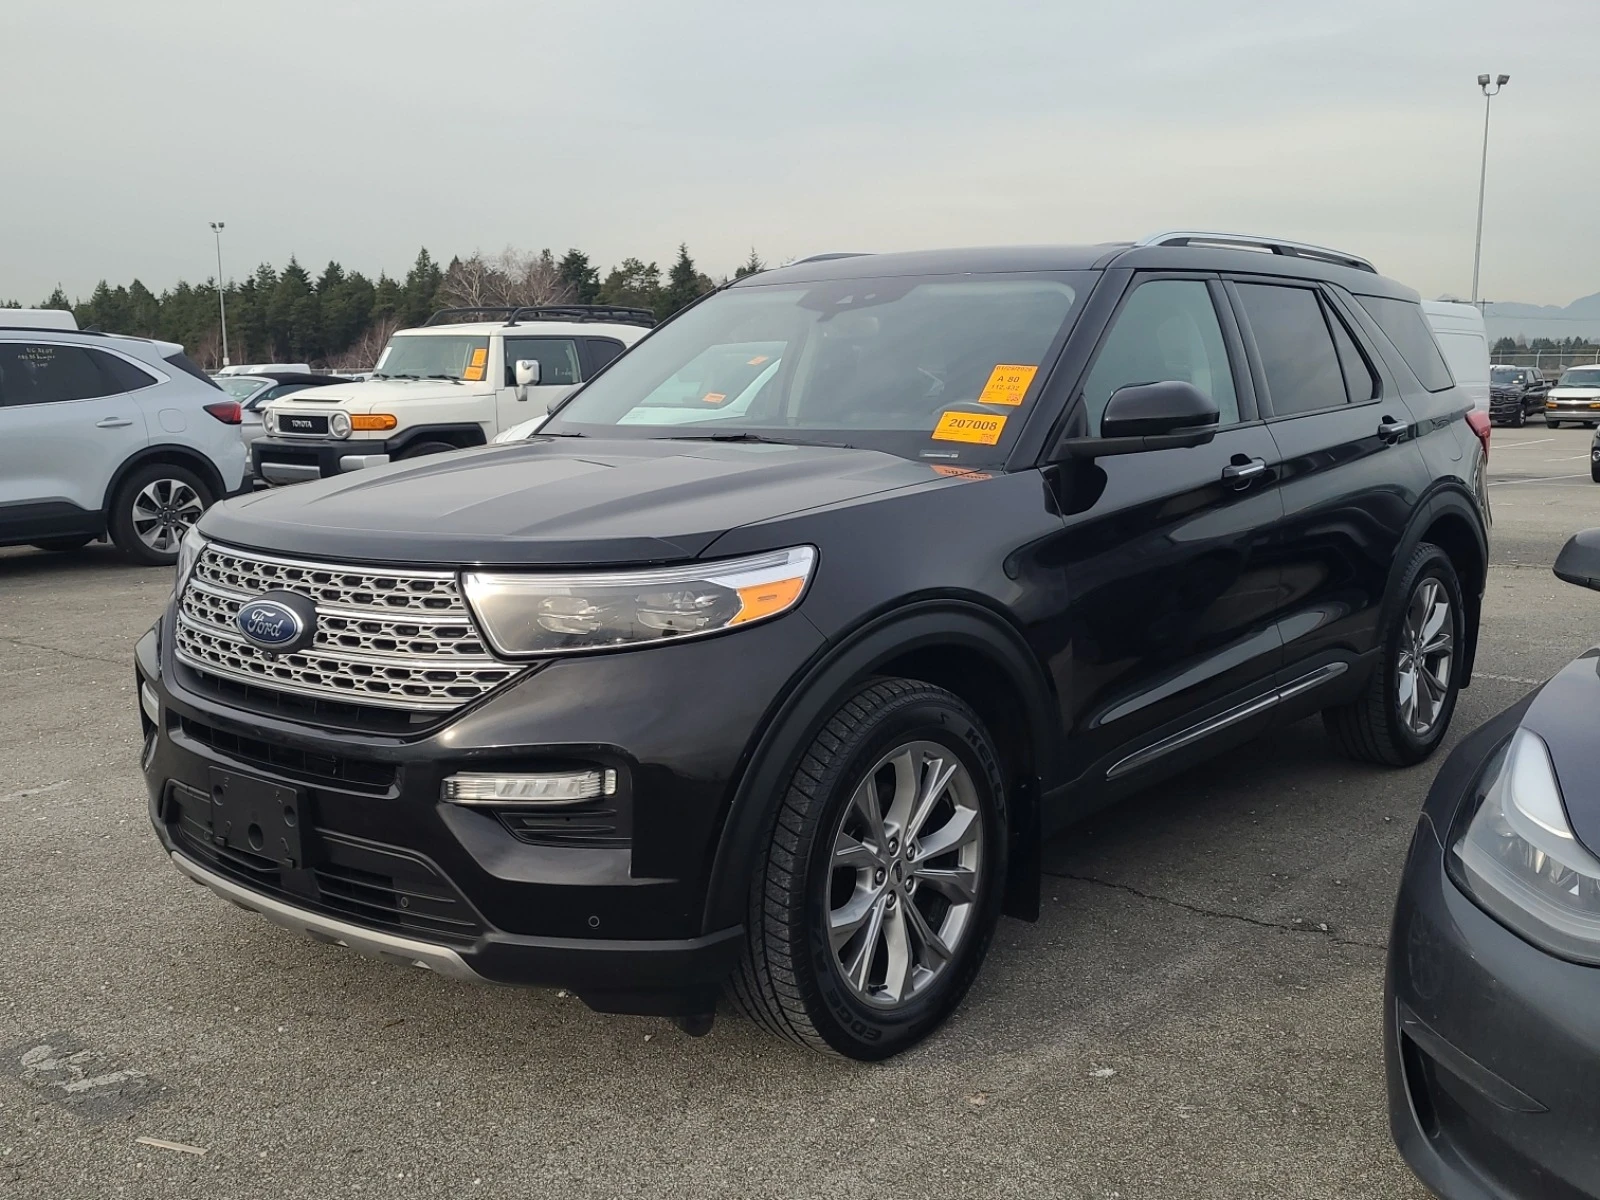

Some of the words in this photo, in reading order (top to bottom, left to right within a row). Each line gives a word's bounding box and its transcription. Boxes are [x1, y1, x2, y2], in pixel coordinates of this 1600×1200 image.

[291, 419, 313, 428] TOYOTA
[948, 418, 998, 432] 207008
[247, 608, 284, 637] Ford
[825, 987, 883, 1042] EDGE
